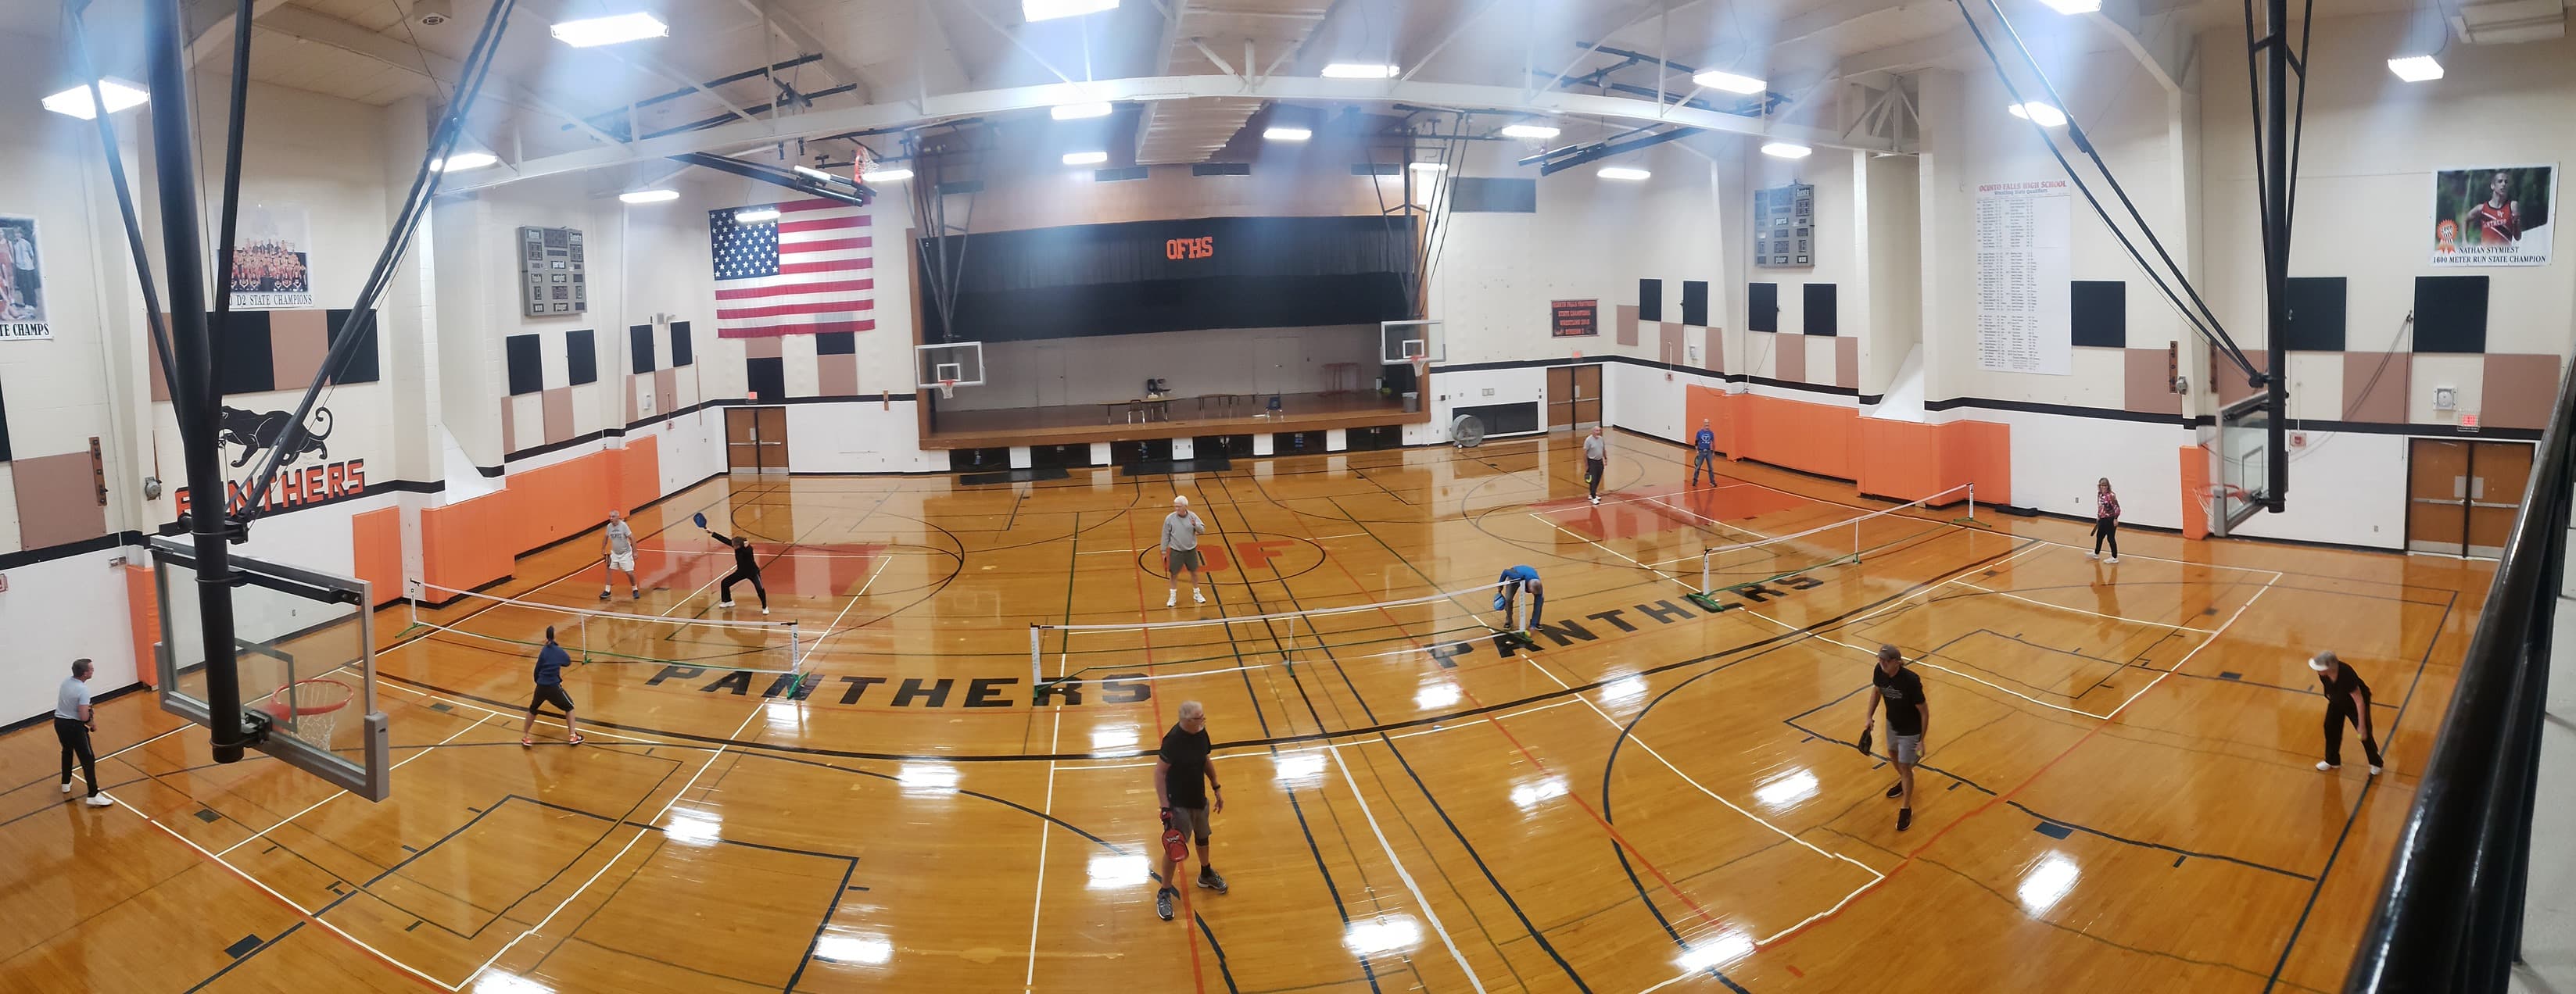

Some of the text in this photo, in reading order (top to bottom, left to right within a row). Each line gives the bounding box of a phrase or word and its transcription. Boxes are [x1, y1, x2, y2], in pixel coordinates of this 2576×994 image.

[1166, 236, 1213, 259] OFHS
[237, 295, 246, 306] D2
[250, 295, 270, 306] STATE
[274, 295, 313, 305] CHAMPIONS
[13, 323, 50, 336] CHAMPS
[1424, 574, 1825, 668] PANTHERS
[644, 664, 1152, 708] PANTHERS
